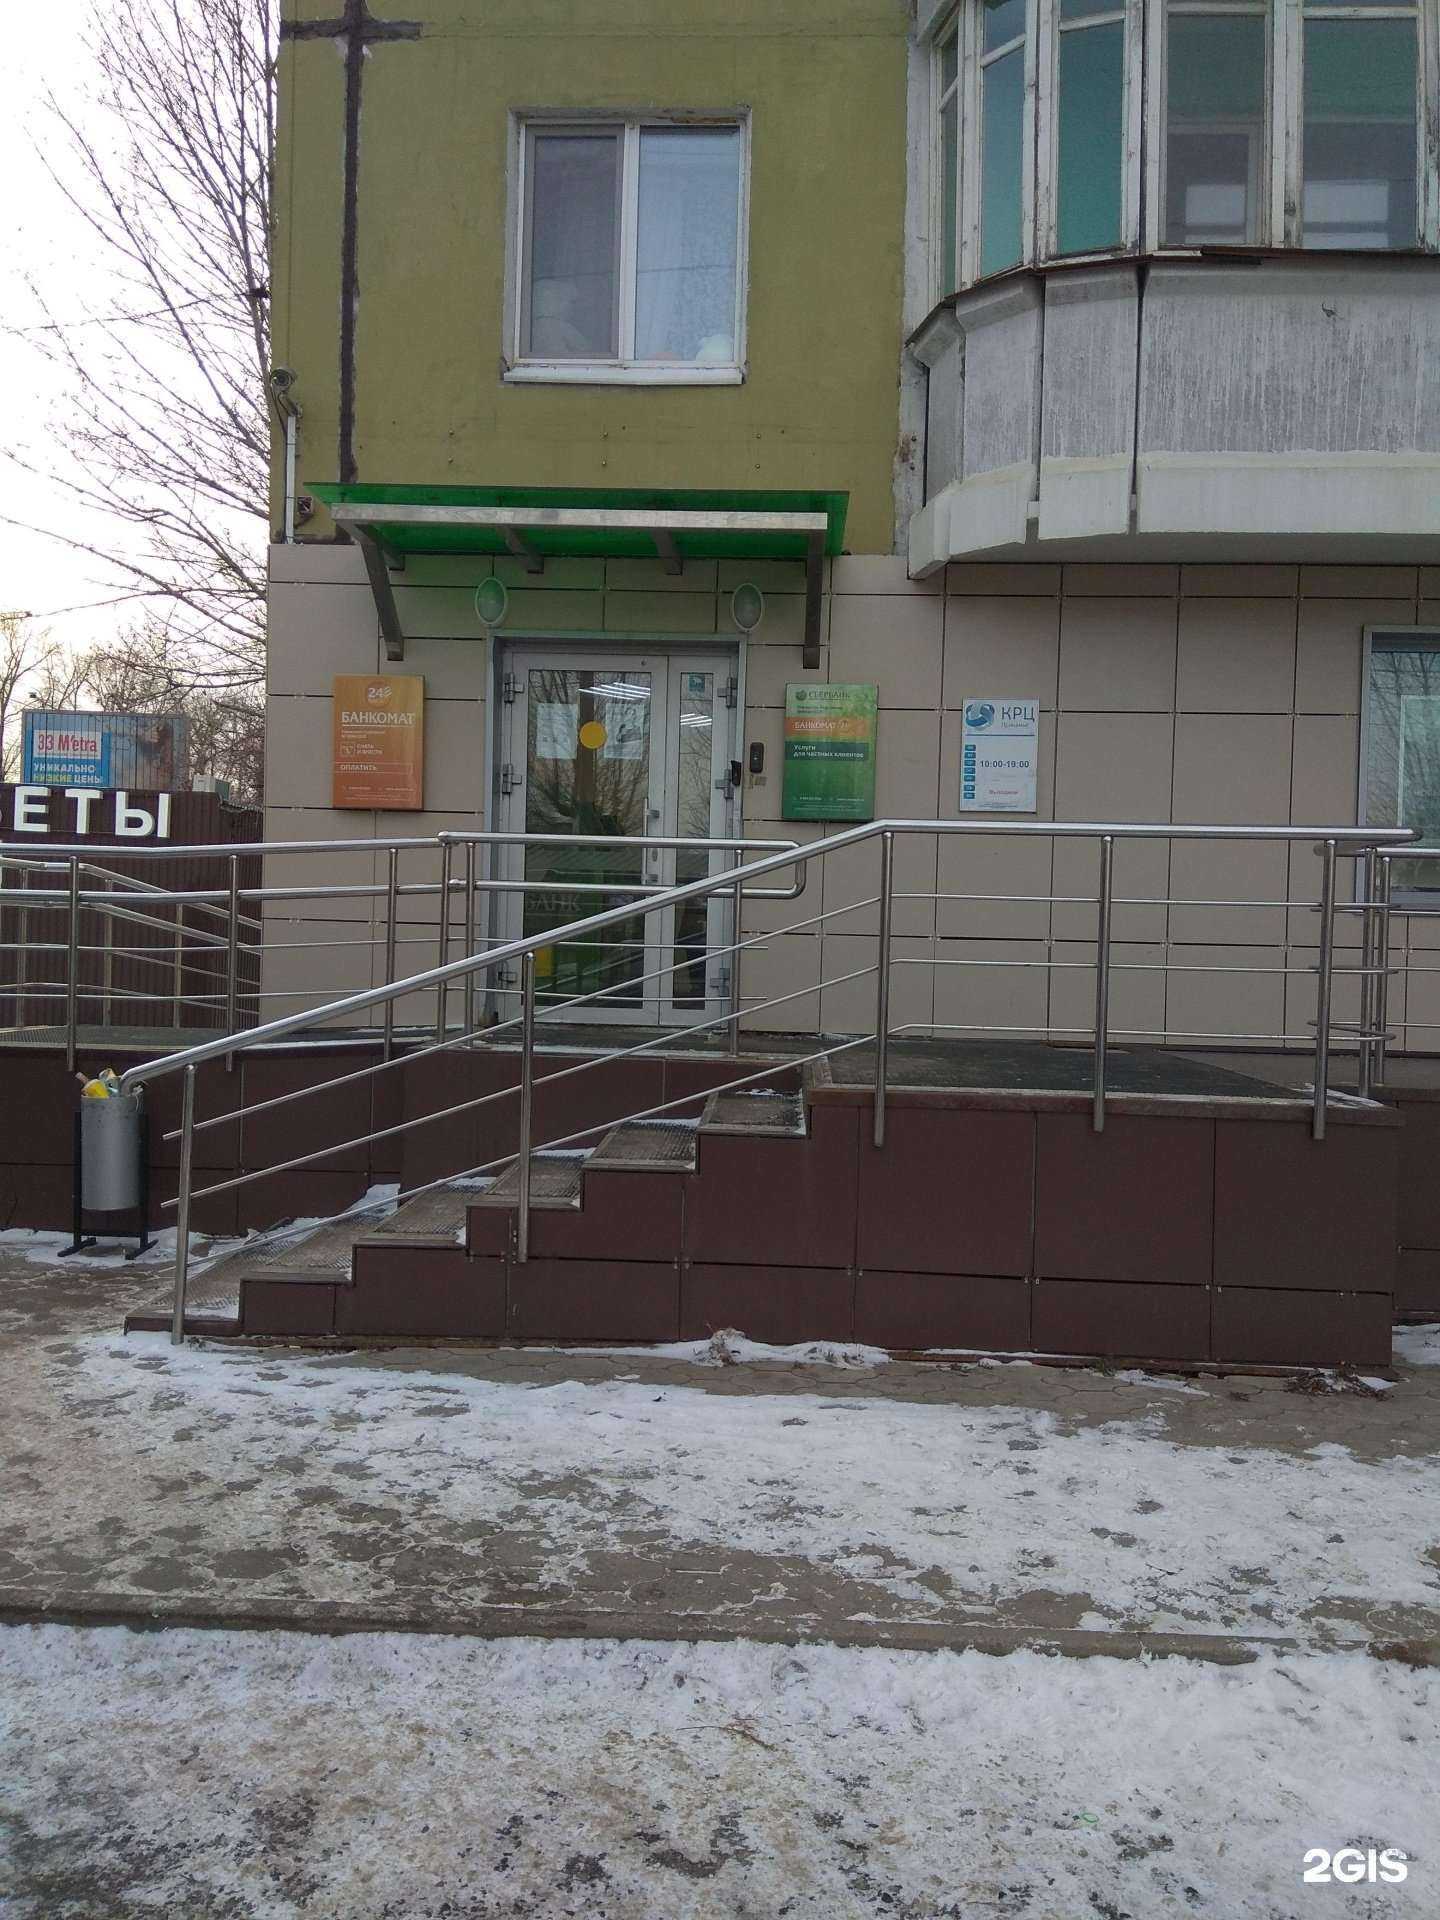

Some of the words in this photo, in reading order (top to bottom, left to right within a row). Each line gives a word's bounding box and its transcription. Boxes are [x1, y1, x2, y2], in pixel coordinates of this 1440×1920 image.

[341, 711, 416, 725] БАНКОМАТ
[1001, 707, 1035, 722] КРЦ
[33, 763, 96, 773] УНИКАЛЬНО
[0, 786, 171, 839] ЕТЫ
